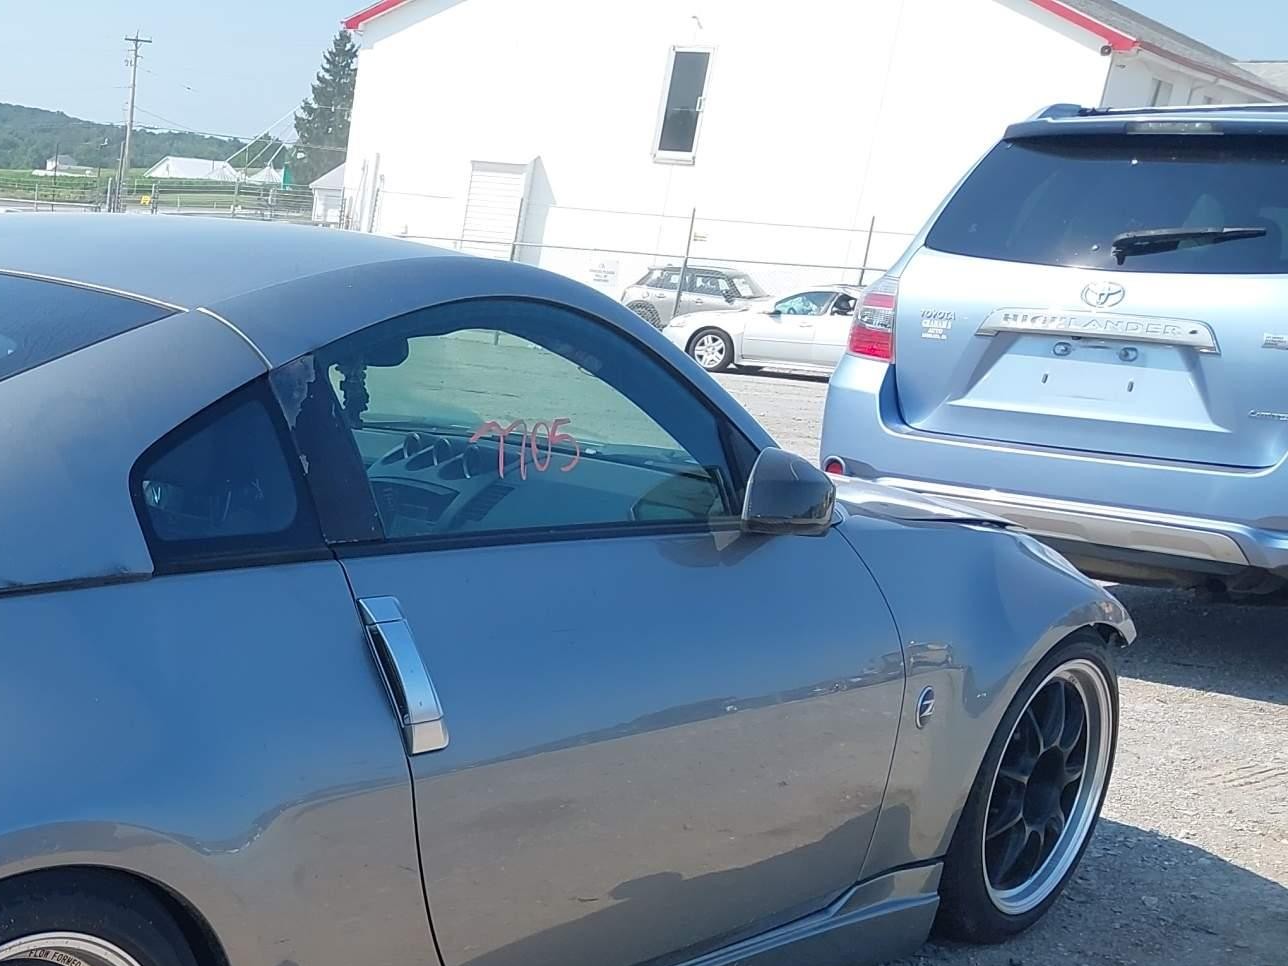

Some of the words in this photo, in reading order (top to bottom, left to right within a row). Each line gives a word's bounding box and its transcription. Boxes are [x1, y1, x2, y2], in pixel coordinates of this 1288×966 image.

[920, 310, 956, 321] TOYOTA
[1001, 312, 1182, 336] HIGHLANDER
[28, 948, 50, 958] FLOW
